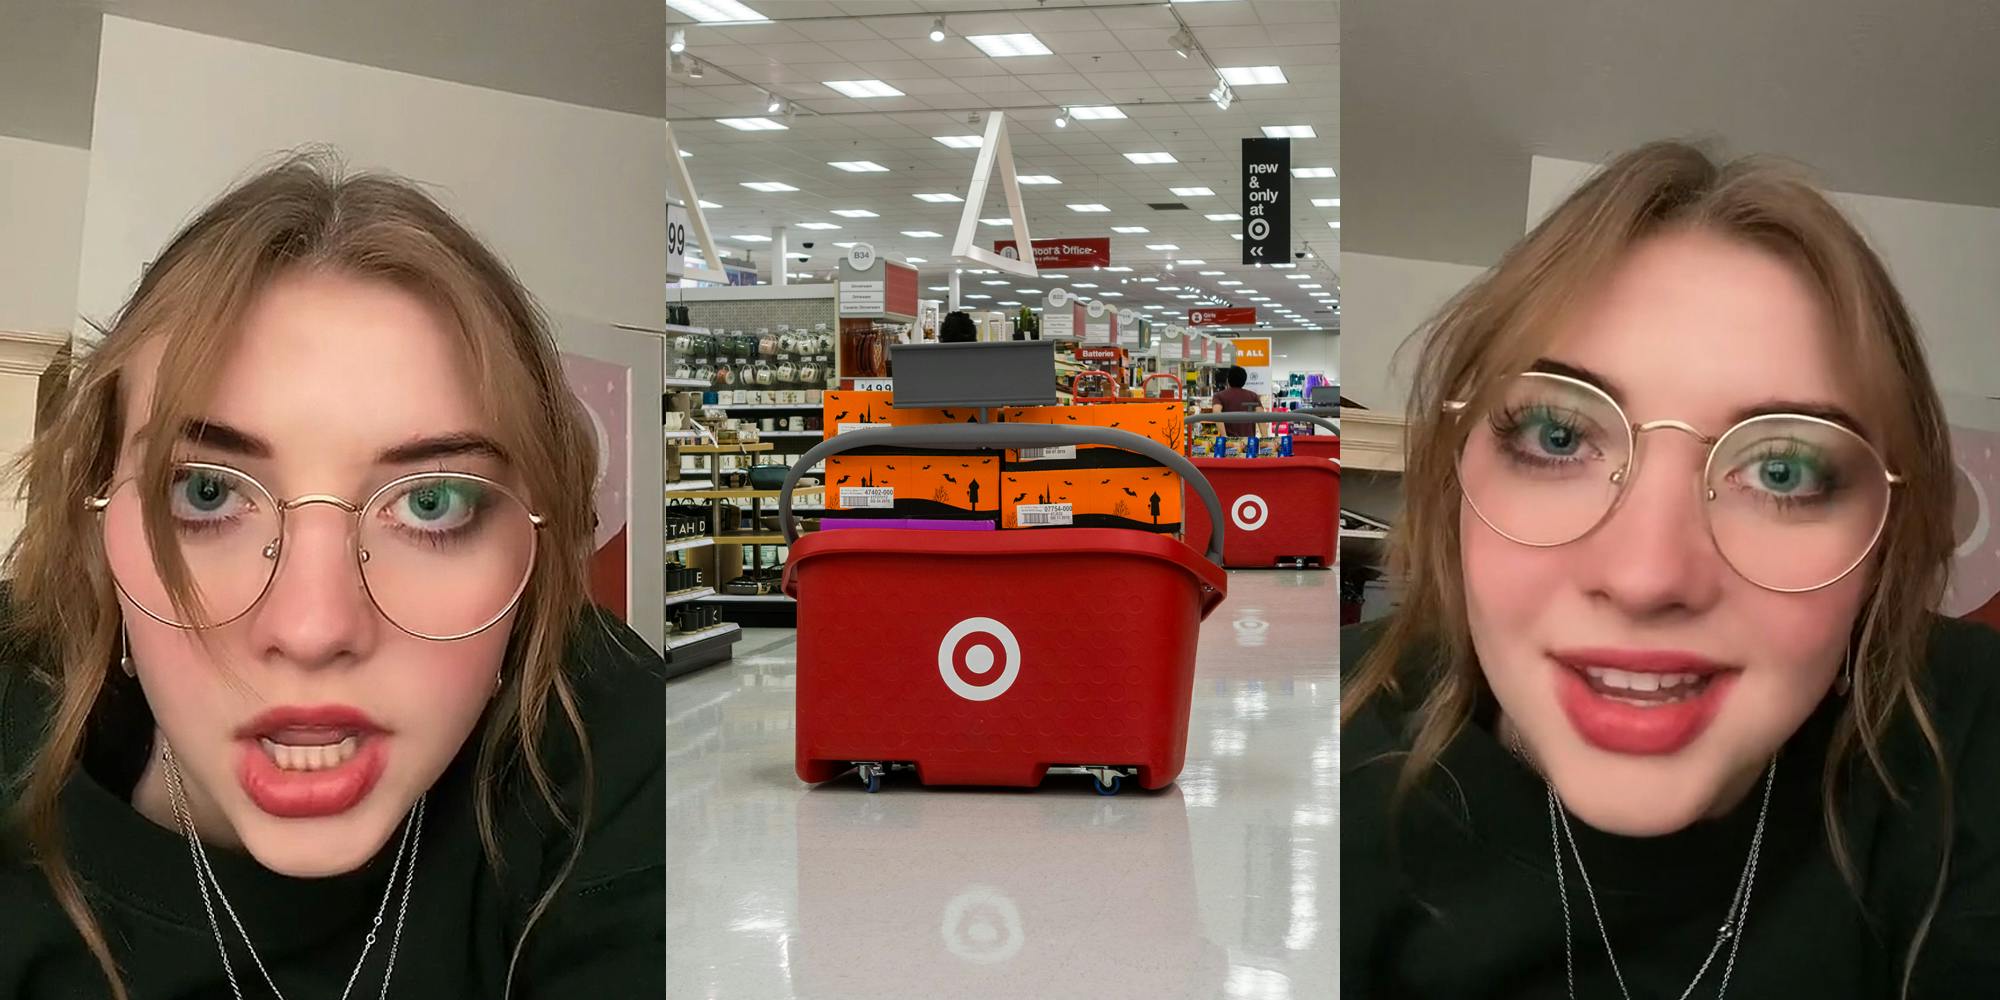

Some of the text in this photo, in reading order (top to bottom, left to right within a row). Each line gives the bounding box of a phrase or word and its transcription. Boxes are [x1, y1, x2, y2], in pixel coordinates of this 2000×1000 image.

[1249, 163, 1279, 174] new
[1249, 175, 1260, 189] &
[1249, 188, 1279, 204] only
[1249, 203, 1264, 216] at
[668, 222, 685, 256] 99
[854, 251, 870, 259] B34
[1054, 246, 1061, 255] &
[1062, 244, 1090, 254] Office
[696, 571, 703, 583] E
